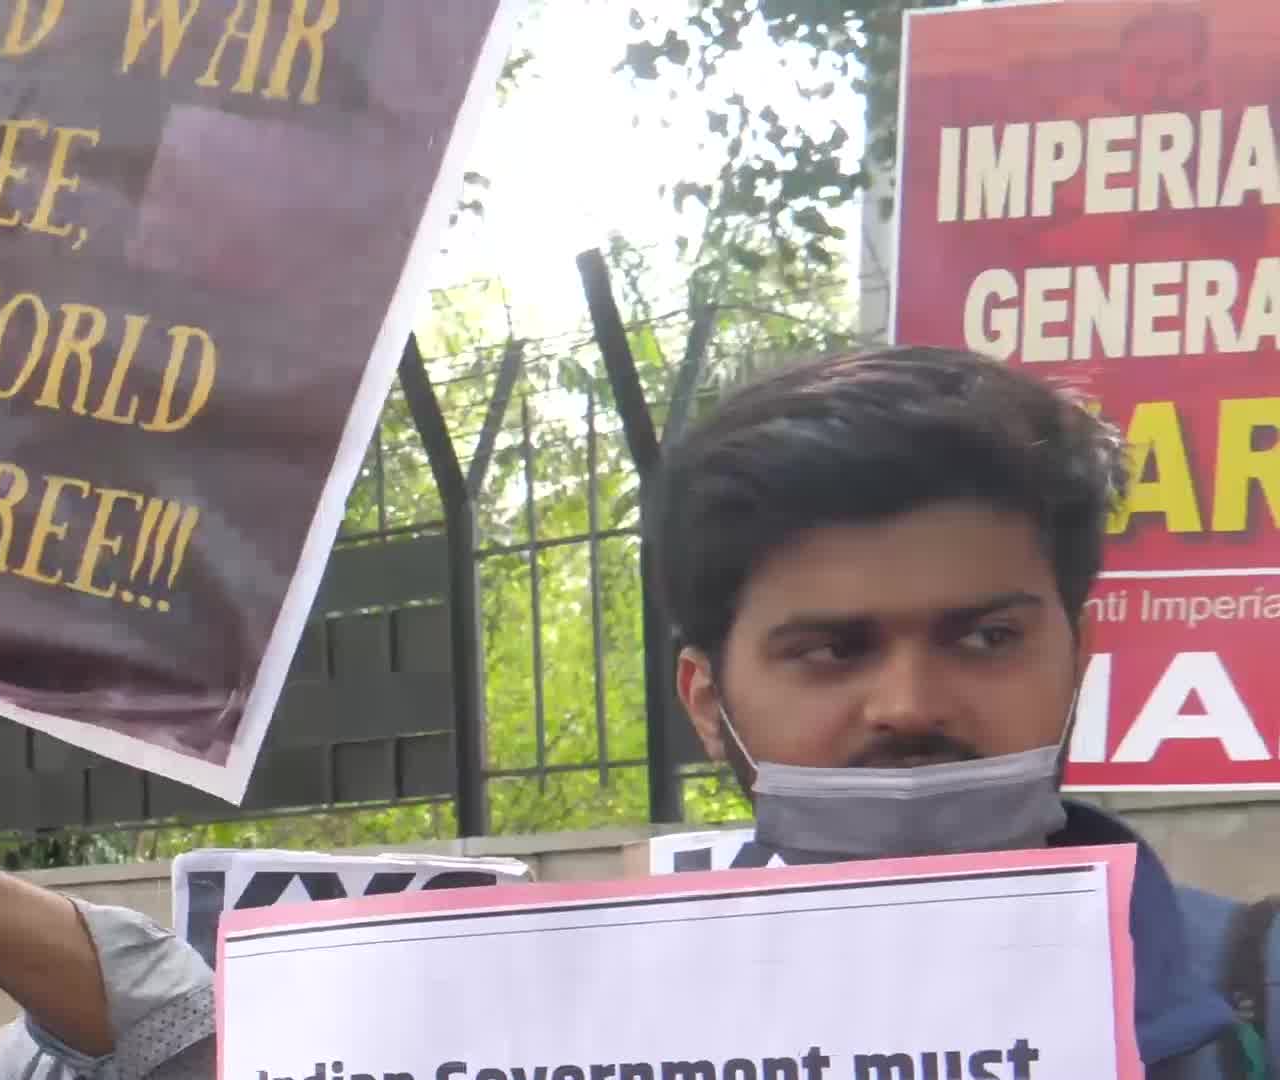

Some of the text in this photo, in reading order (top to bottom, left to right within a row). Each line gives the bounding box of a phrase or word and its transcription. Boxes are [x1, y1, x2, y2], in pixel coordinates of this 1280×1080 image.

[117, 0, 339, 104] WAR
[937, 105, 1280, 223] IMPERIA
[1086, 397, 1280, 534] AR
[1082, 591, 1128, 622] nti
